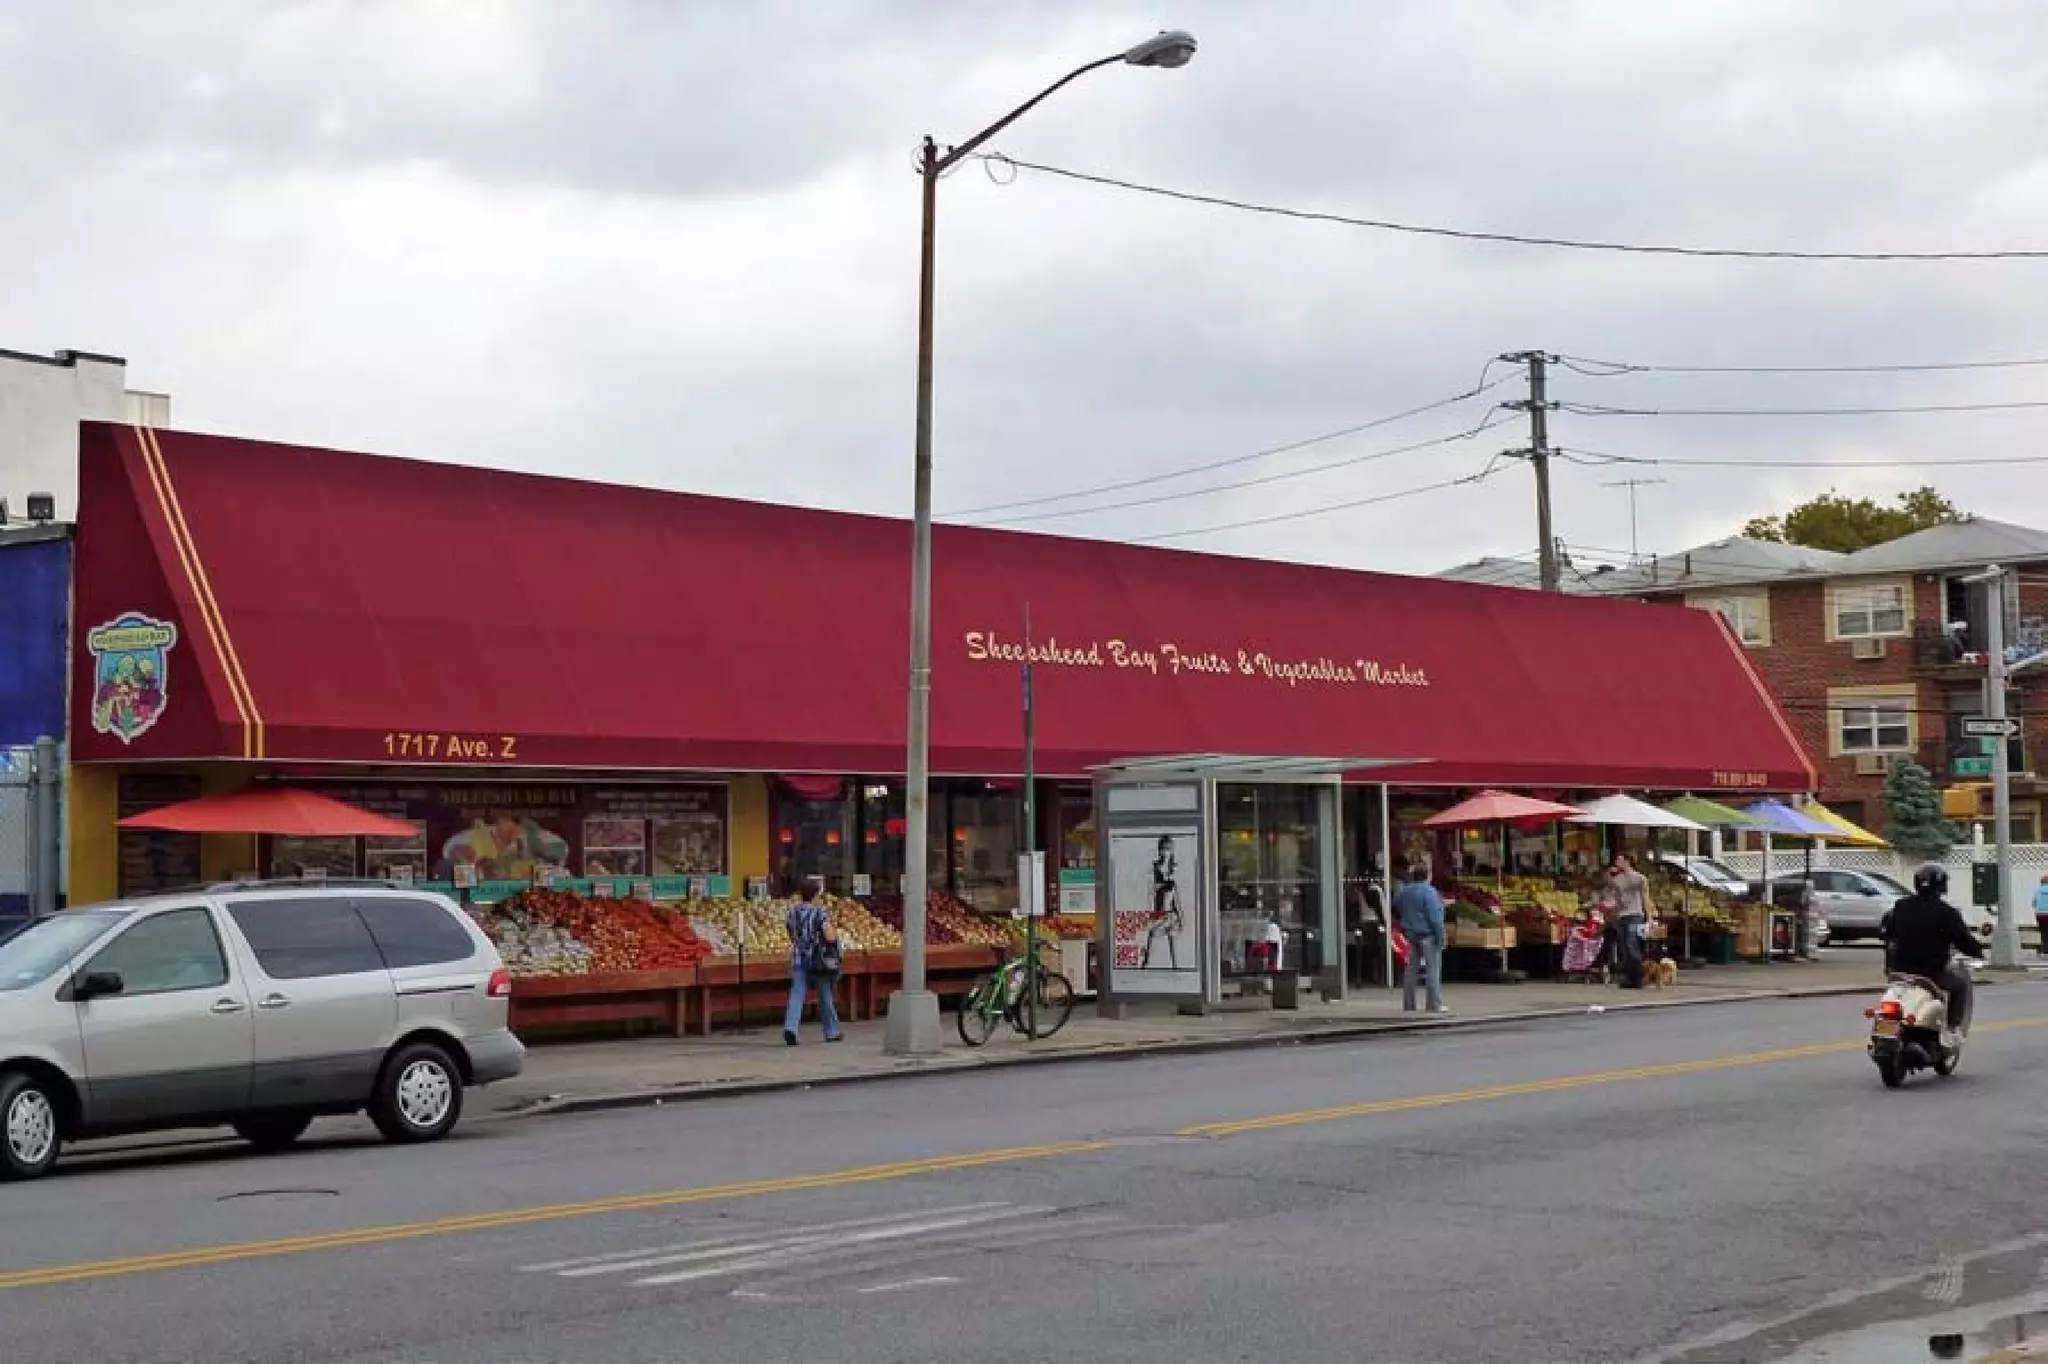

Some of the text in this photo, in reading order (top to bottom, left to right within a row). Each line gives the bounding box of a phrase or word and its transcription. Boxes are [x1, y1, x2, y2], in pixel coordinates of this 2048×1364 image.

[1107, 639, 1157, 674] Bay
[1161, 643, 1231, 674] Fruits
[1237, 648, 1254, 674] &
[1254, 653, 1358, 687] Vegetables
[1356, 659, 1429, 685] Market
[385, 733, 517, 758] 1717 Ave. Z
